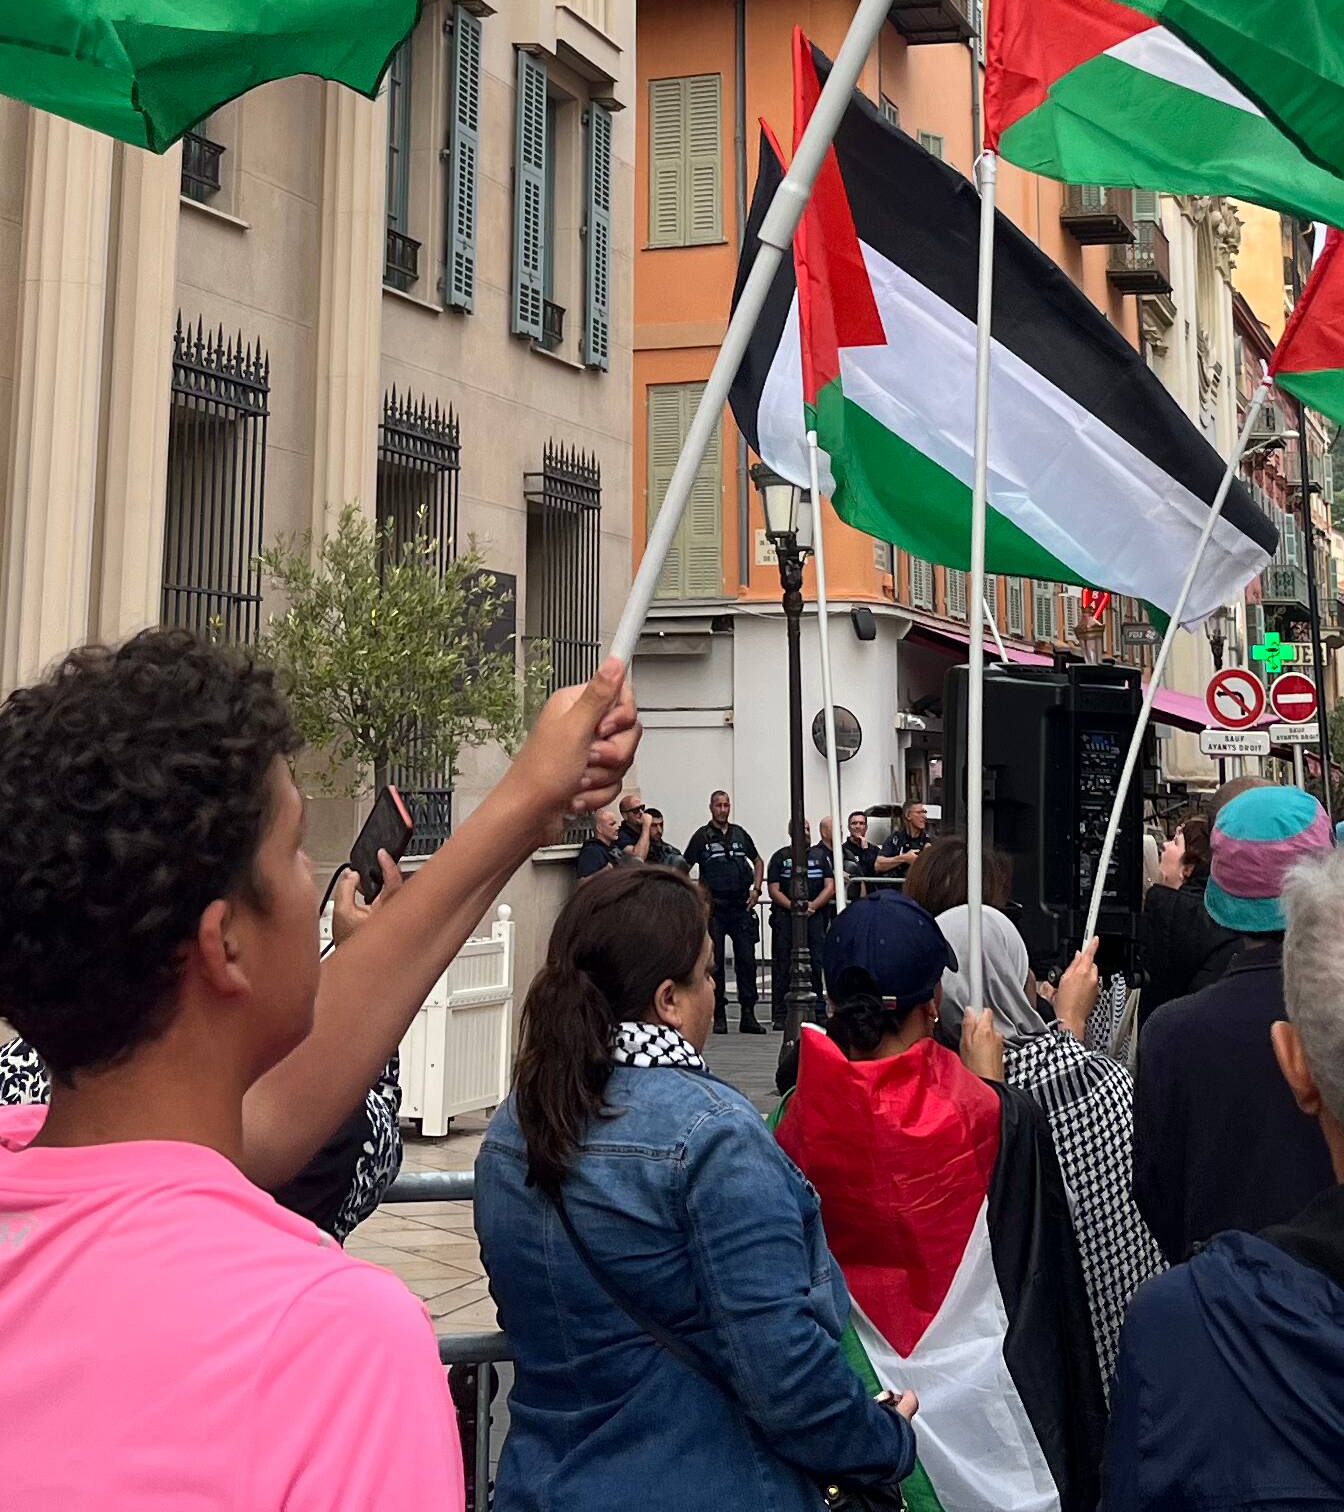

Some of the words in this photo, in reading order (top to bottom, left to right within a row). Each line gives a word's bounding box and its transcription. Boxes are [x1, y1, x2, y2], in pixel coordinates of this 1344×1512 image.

[1224, 735, 1245, 743] SAUF
[1207, 743, 1237, 751] AYANTS
[1238, 744, 1262, 752] DROIT
